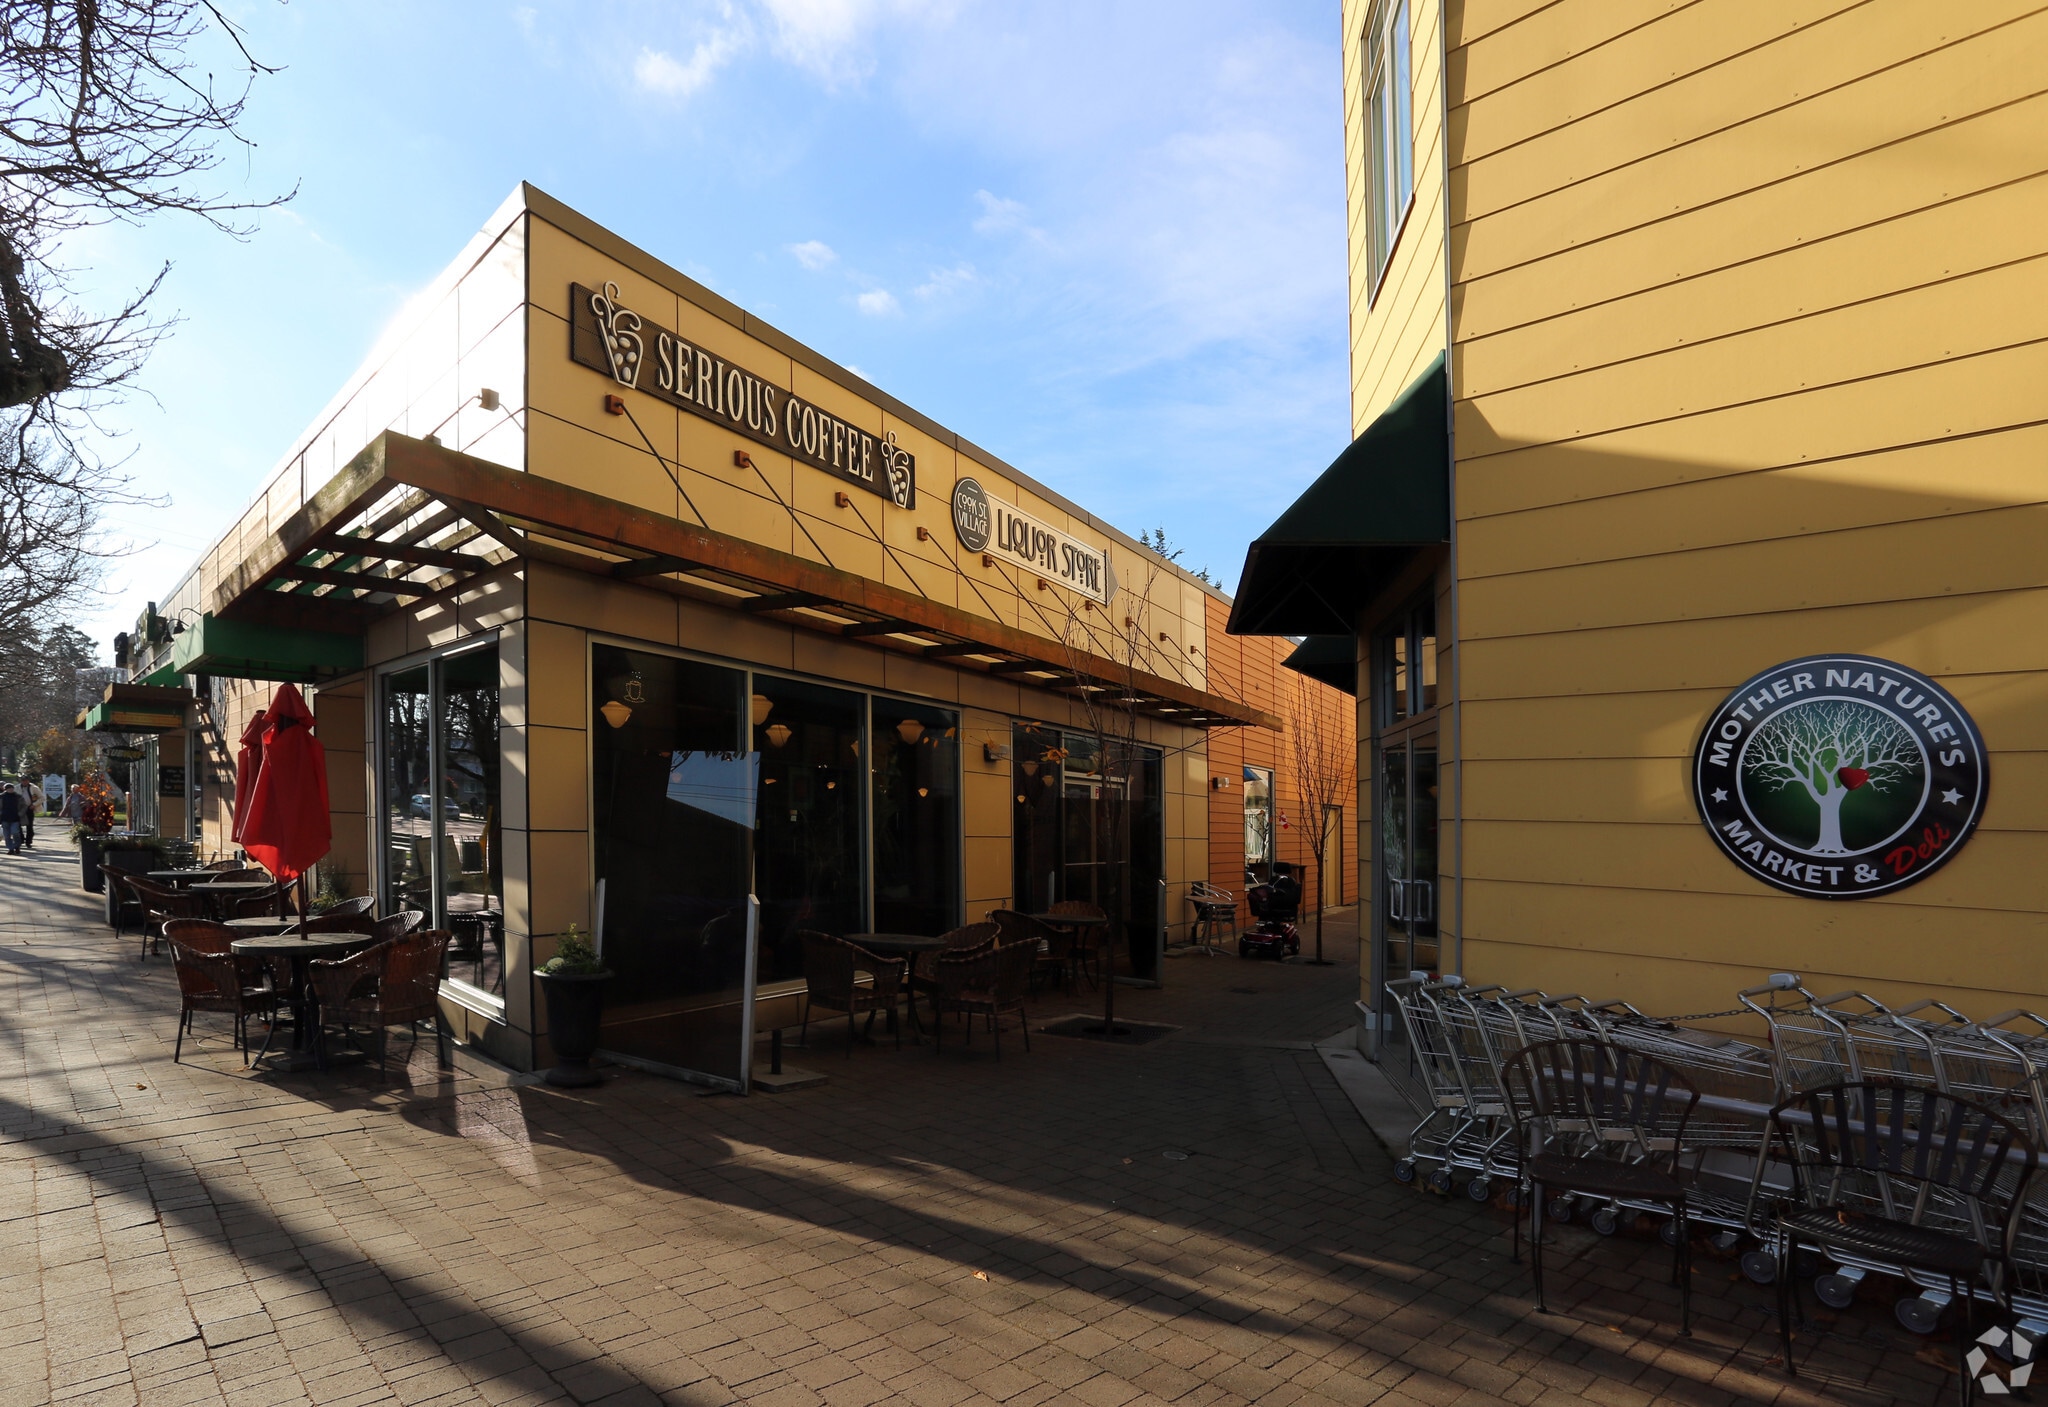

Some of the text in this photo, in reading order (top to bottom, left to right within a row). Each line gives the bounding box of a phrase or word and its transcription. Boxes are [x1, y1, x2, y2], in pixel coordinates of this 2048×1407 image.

[657, 332, 874, 483] SERIOUS COFFEE
[957, 492, 988, 520] COOK ST
[958, 509, 988, 537] VILLAGE
[997, 508, 1102, 593] LIQUOR STORE
[1709, 669, 1966, 768] MOTHER NATURE'S
[1722, 818, 1950, 886] MARKET & Deli
